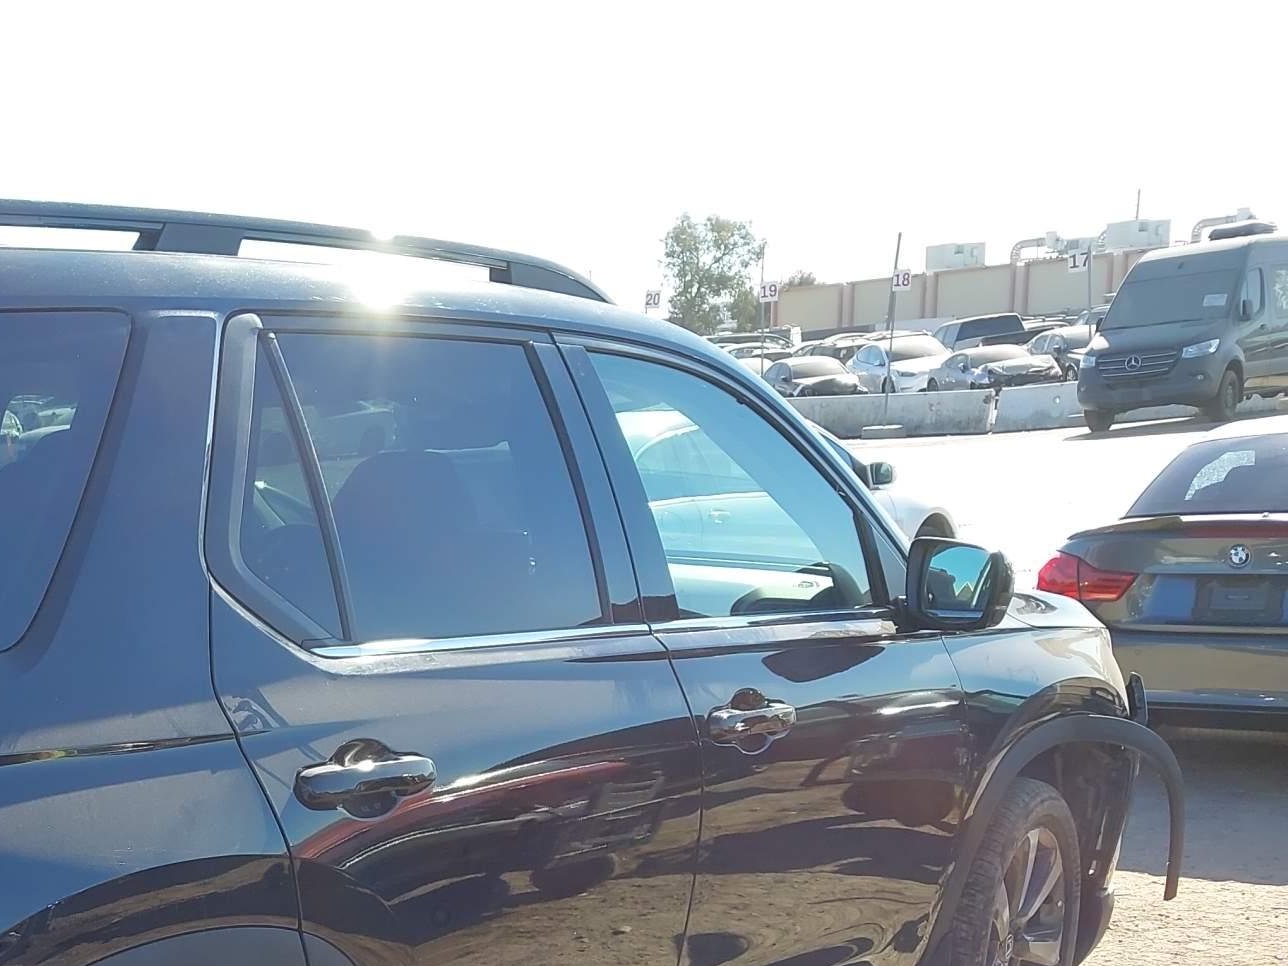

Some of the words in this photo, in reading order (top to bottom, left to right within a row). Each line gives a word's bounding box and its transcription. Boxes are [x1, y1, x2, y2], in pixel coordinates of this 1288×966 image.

[1069, 251, 1089, 269] 17
[894, 272, 911, 287] 18
[645, 292, 661, 306] 20
[761, 284, 778, 299] 19
